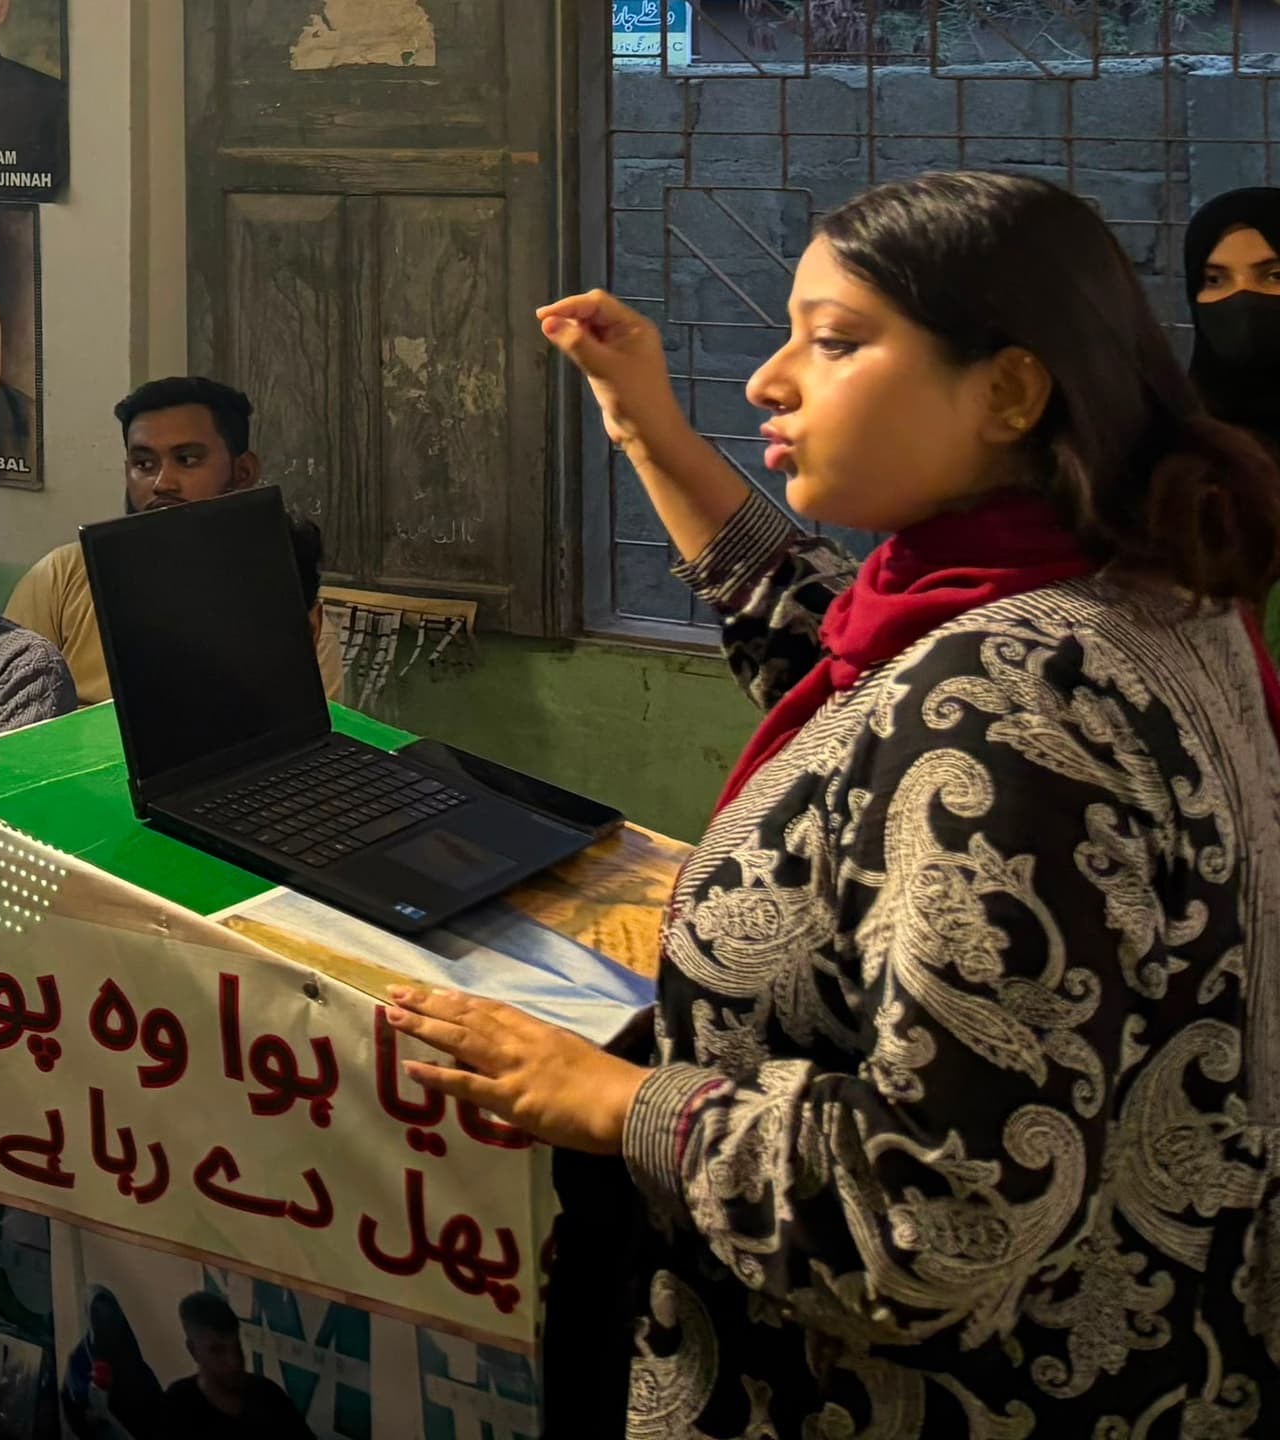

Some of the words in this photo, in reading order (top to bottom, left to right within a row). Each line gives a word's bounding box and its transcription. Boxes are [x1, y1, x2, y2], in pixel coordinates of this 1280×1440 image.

[88, 978, 189, 1089] وہ
[219, 971, 339, 1128] ہوا
[89, 1086, 171, 1205] رہا
[192, 1145, 334, 1229] دے
[358, 1168, 520, 1315] پھل
